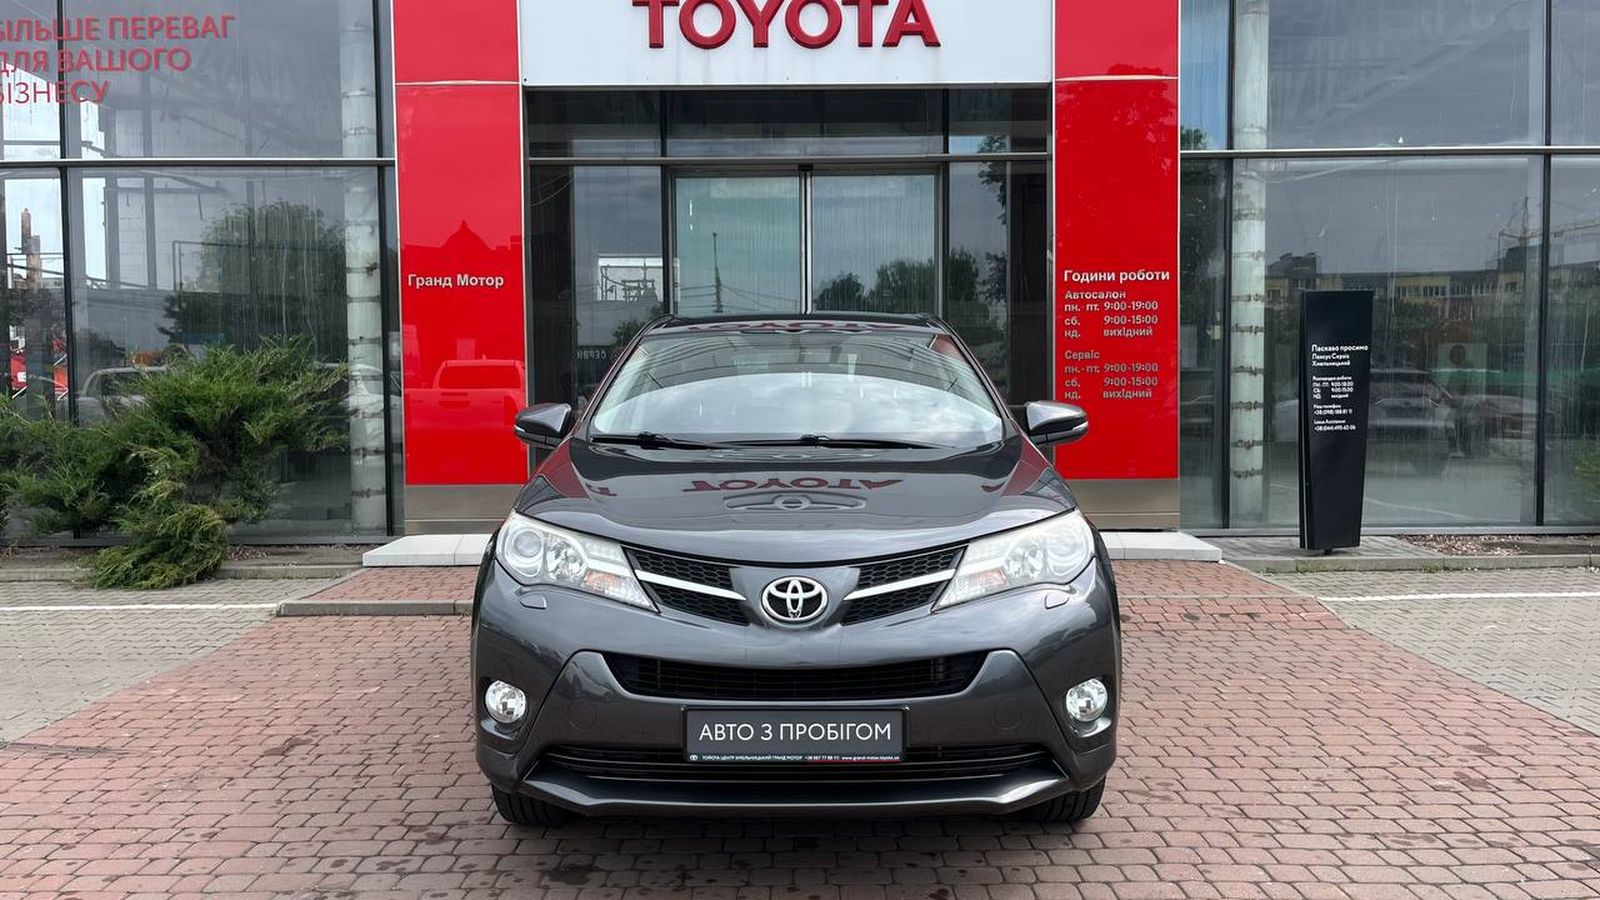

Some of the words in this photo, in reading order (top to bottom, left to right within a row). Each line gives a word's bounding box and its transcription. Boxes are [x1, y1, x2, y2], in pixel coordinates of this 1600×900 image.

[108, 15, 236, 41] ПЕРЕВАГ
[632, 0, 941, 49] TOYOTA
[58, 46, 192, 73] ВАШОГО
[408, 273, 453, 289] Гранд
[456, 273, 504, 289] Мотор
[1064, 270, 1115, 284] Години
[1120, 269, 1170, 284] роботи
[1065, 291, 1126, 299] Автосалон
[1104, 301, 1158, 310] 9:00-19:00
[1064, 316, 1081, 326] сб.
[1104, 315, 1158, 325] 9:00-15:00
[1064, 329, 1081, 339] нд.
[1104, 327, 1153, 337] вихідний
[1065, 350, 1100, 361] Сервіс
[1104, 363, 1158, 372] 9:00-19:00
[1064, 378, 1081, 388] сб.
[1104, 377, 1158, 387] 9:00-15:00
[1064, 391, 1081, 401] нд.
[1103, 389, 1152, 399] вихідний
[699, 722, 755, 741] АВТО
[760, 722, 773, 741] З
[779, 722, 891, 741] ПРОБІГОМ
